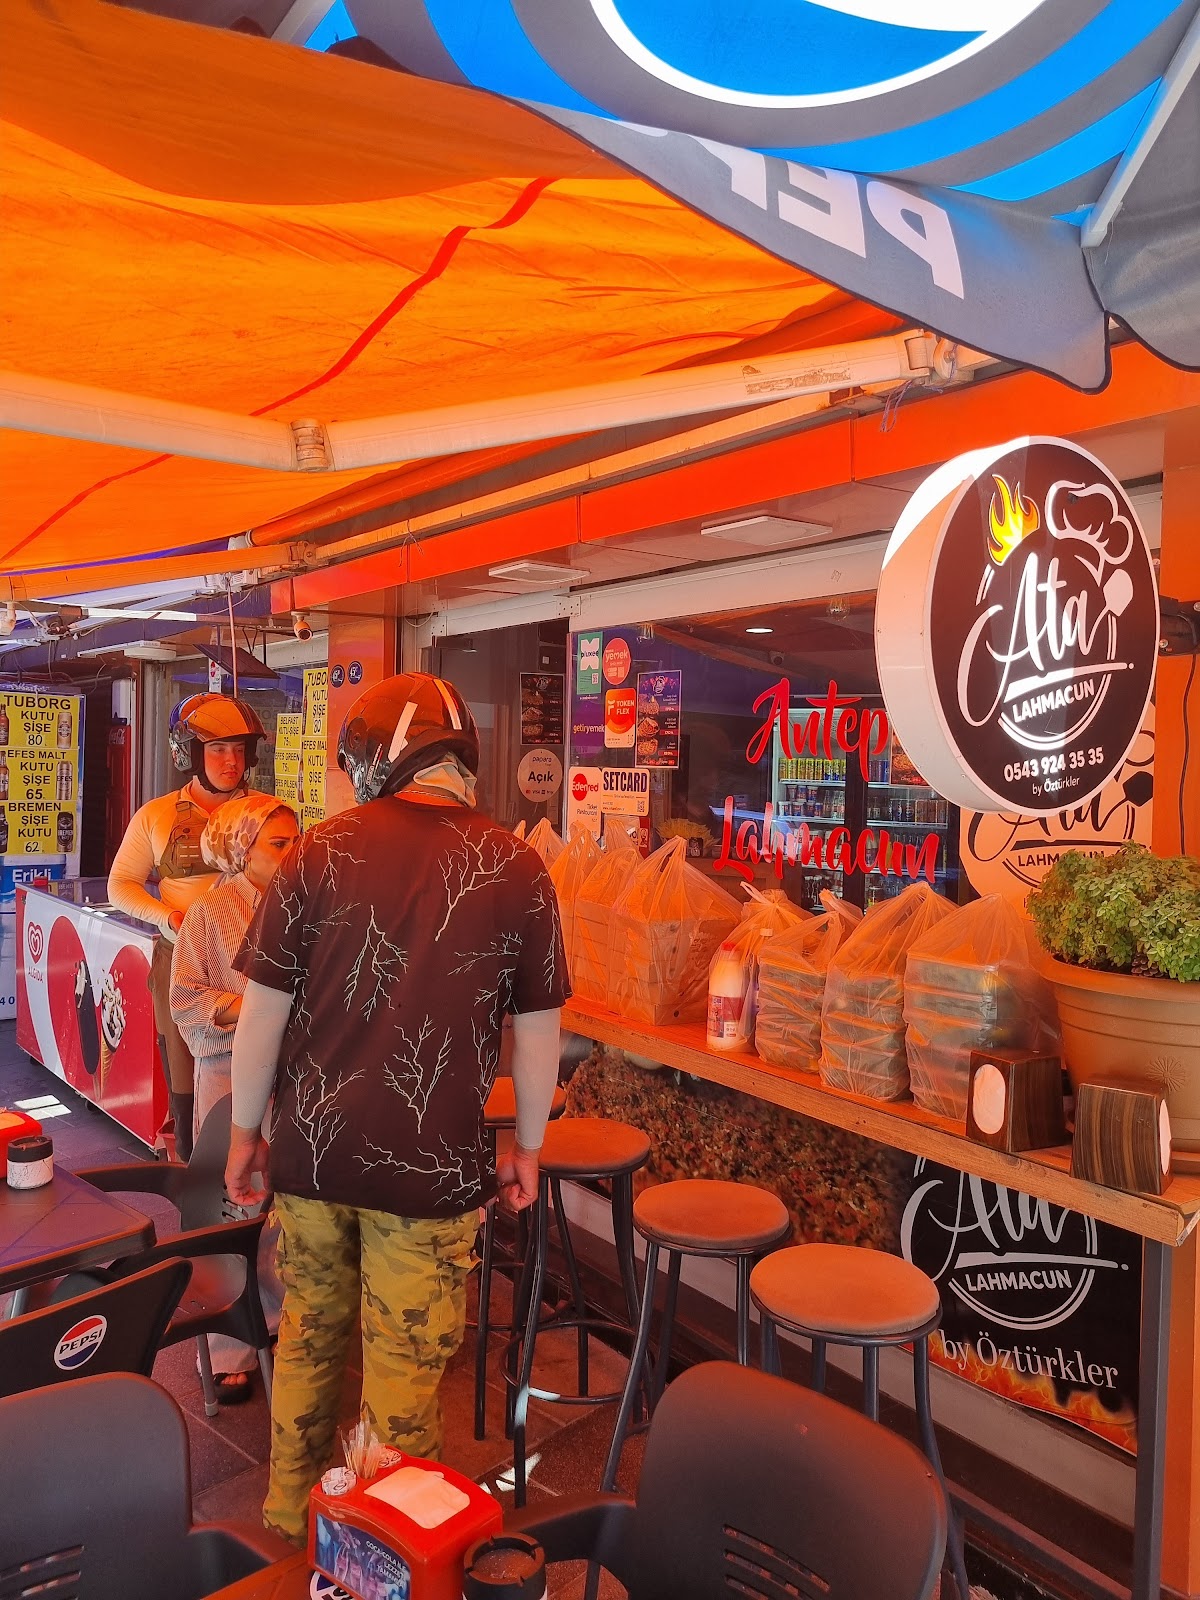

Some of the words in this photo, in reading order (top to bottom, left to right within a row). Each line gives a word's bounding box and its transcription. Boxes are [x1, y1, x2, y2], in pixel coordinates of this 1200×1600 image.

[957, 551, 1090, 728] Ata
[606, 649, 628, 663] yemek
[307, 672, 328, 686] TUBO
[4, 695, 71, 710] TUBORG
[1012, 679, 1095, 723] LAHMACUN
[21, 710, 55, 721] KUTU
[313, 704, 326, 718] ŞİŞE
[617, 707, 630, 715] FLEX
[23, 721, 51, 734] ŞİŞE
[573, 723, 605, 733] getiryemek
[746, 677, 889, 782] Antep
[303, 740, 316, 750] EFES
[317, 741, 327, 750] MAL
[7, 749, 36, 759] EFES
[38, 751, 67, 760] MALT
[307, 755, 324, 767] KUTU
[20, 761, 54, 772] KUTU
[1003, 758, 1039, 783] 0543
[1040, 753, 1067, 775] 924
[1068, 750, 1085, 769] 35
[1087, 746, 1105, 764] 35
[22, 773, 51, 786] ŞİŞE
[309, 770, 322, 785] ŞİŞE
[527, 771, 554, 784] Açık
[603, 771, 647, 793] SETCARD
[572, 783, 599, 793] Edenred
[1032, 783, 1042, 796] by
[1043, 777, 1080, 793] Öztürkler
[8, 802, 62, 812] BREMEN
[21, 814, 49, 827] ŞİŞE
[18, 828, 52, 838] KUTU
[712, 796, 940, 884] Lahmacun
[12, 868, 52, 883] Erikli
[965, 1269, 1072, 1292] LAHMACUN
[59, 1328, 103, 1355] PEPSI
[938, 1328, 971, 1370] by
[976, 1330, 1119, 1389] Öztürkler
